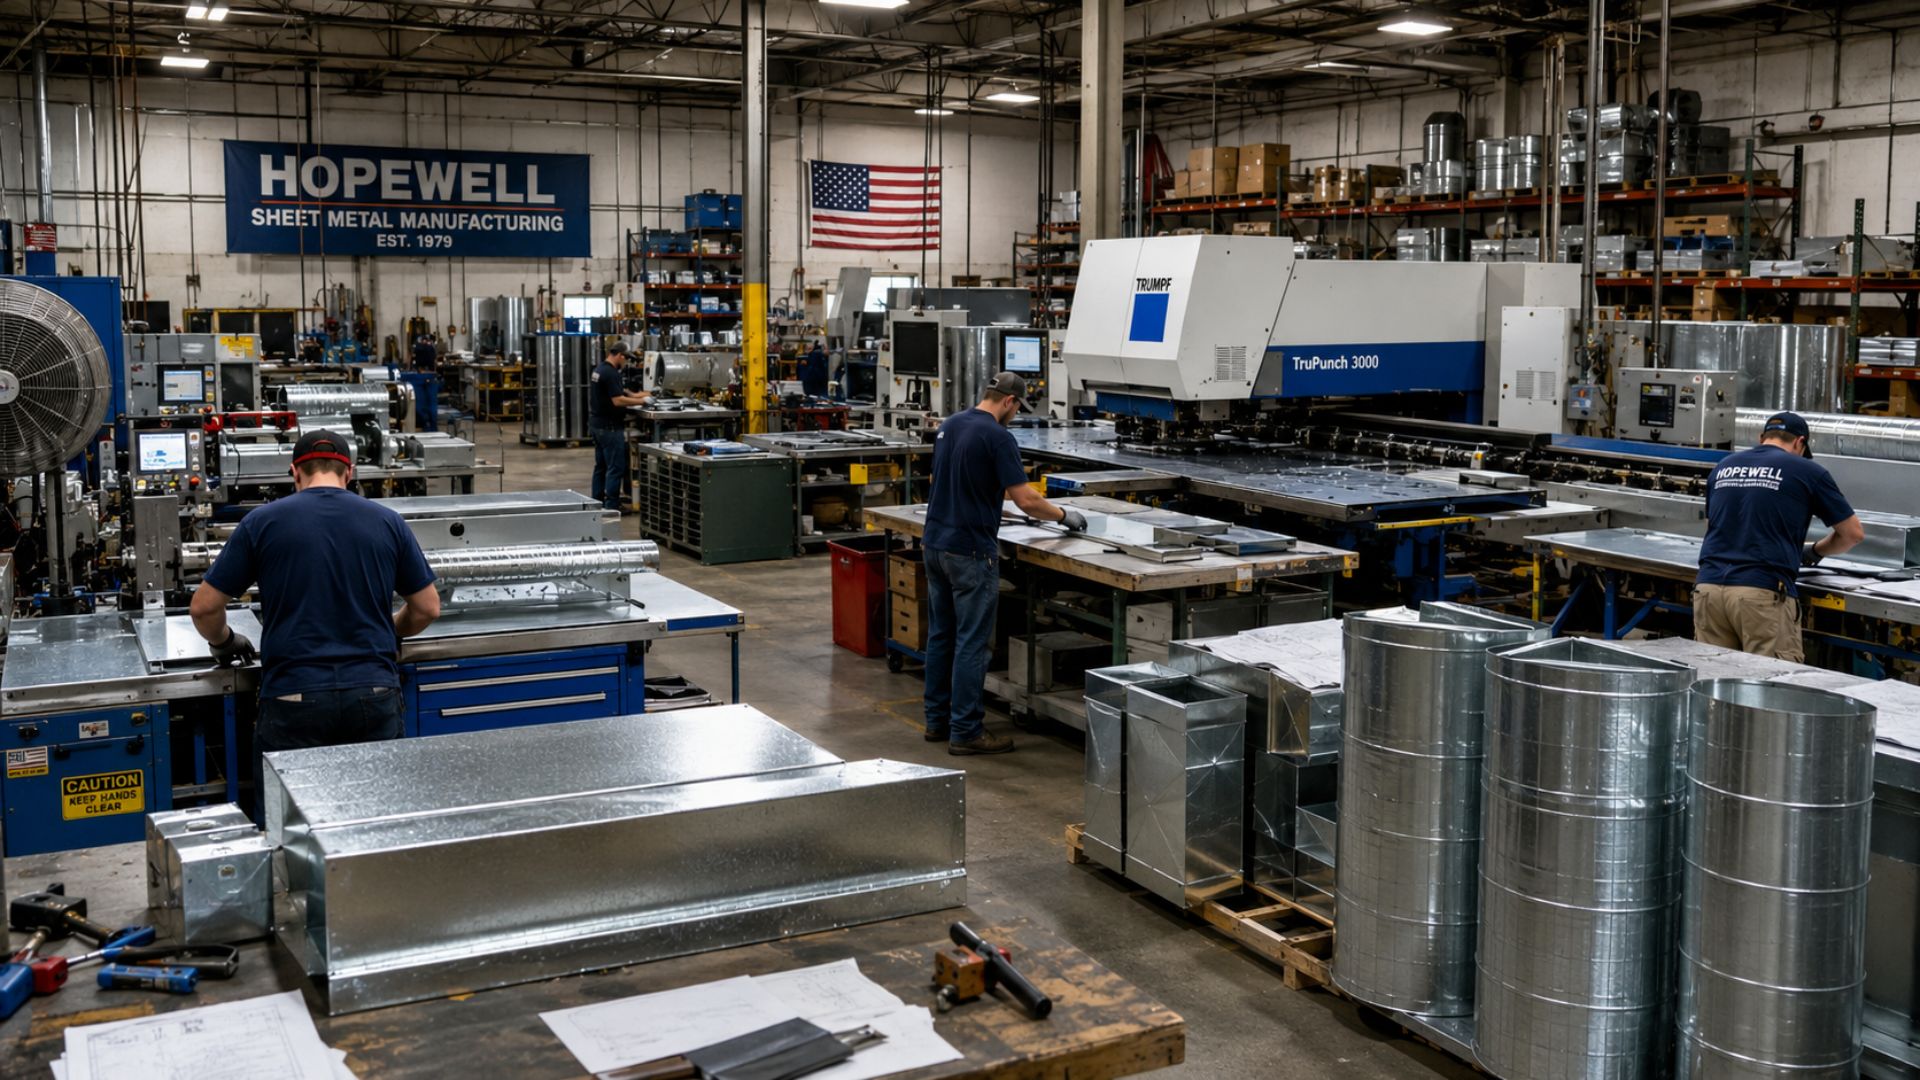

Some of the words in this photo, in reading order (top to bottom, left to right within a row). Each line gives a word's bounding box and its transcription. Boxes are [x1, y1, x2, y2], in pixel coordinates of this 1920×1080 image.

[260, 154, 556, 204] HOPEWELL
[251, 208, 321, 227] SHEET
[328, 210, 394, 228] METAL
[400, 212, 565, 232] MANUFACTURING
[376, 234, 411, 247] EST.
[416, 235, 453, 248] 1979
[1136, 277, 1172, 292] TRUMPF
[1292, 355, 1348, 370] TruPunch
[1351, 355, 1379, 369] 3000
[1716, 466, 1783, 481] HOPEWELL
[66, 773, 139, 793] CAUTION
[69, 794, 97, 806] KEEP
[100, 790, 137, 802] HANDS
[85, 802, 122, 814] CLEAR
